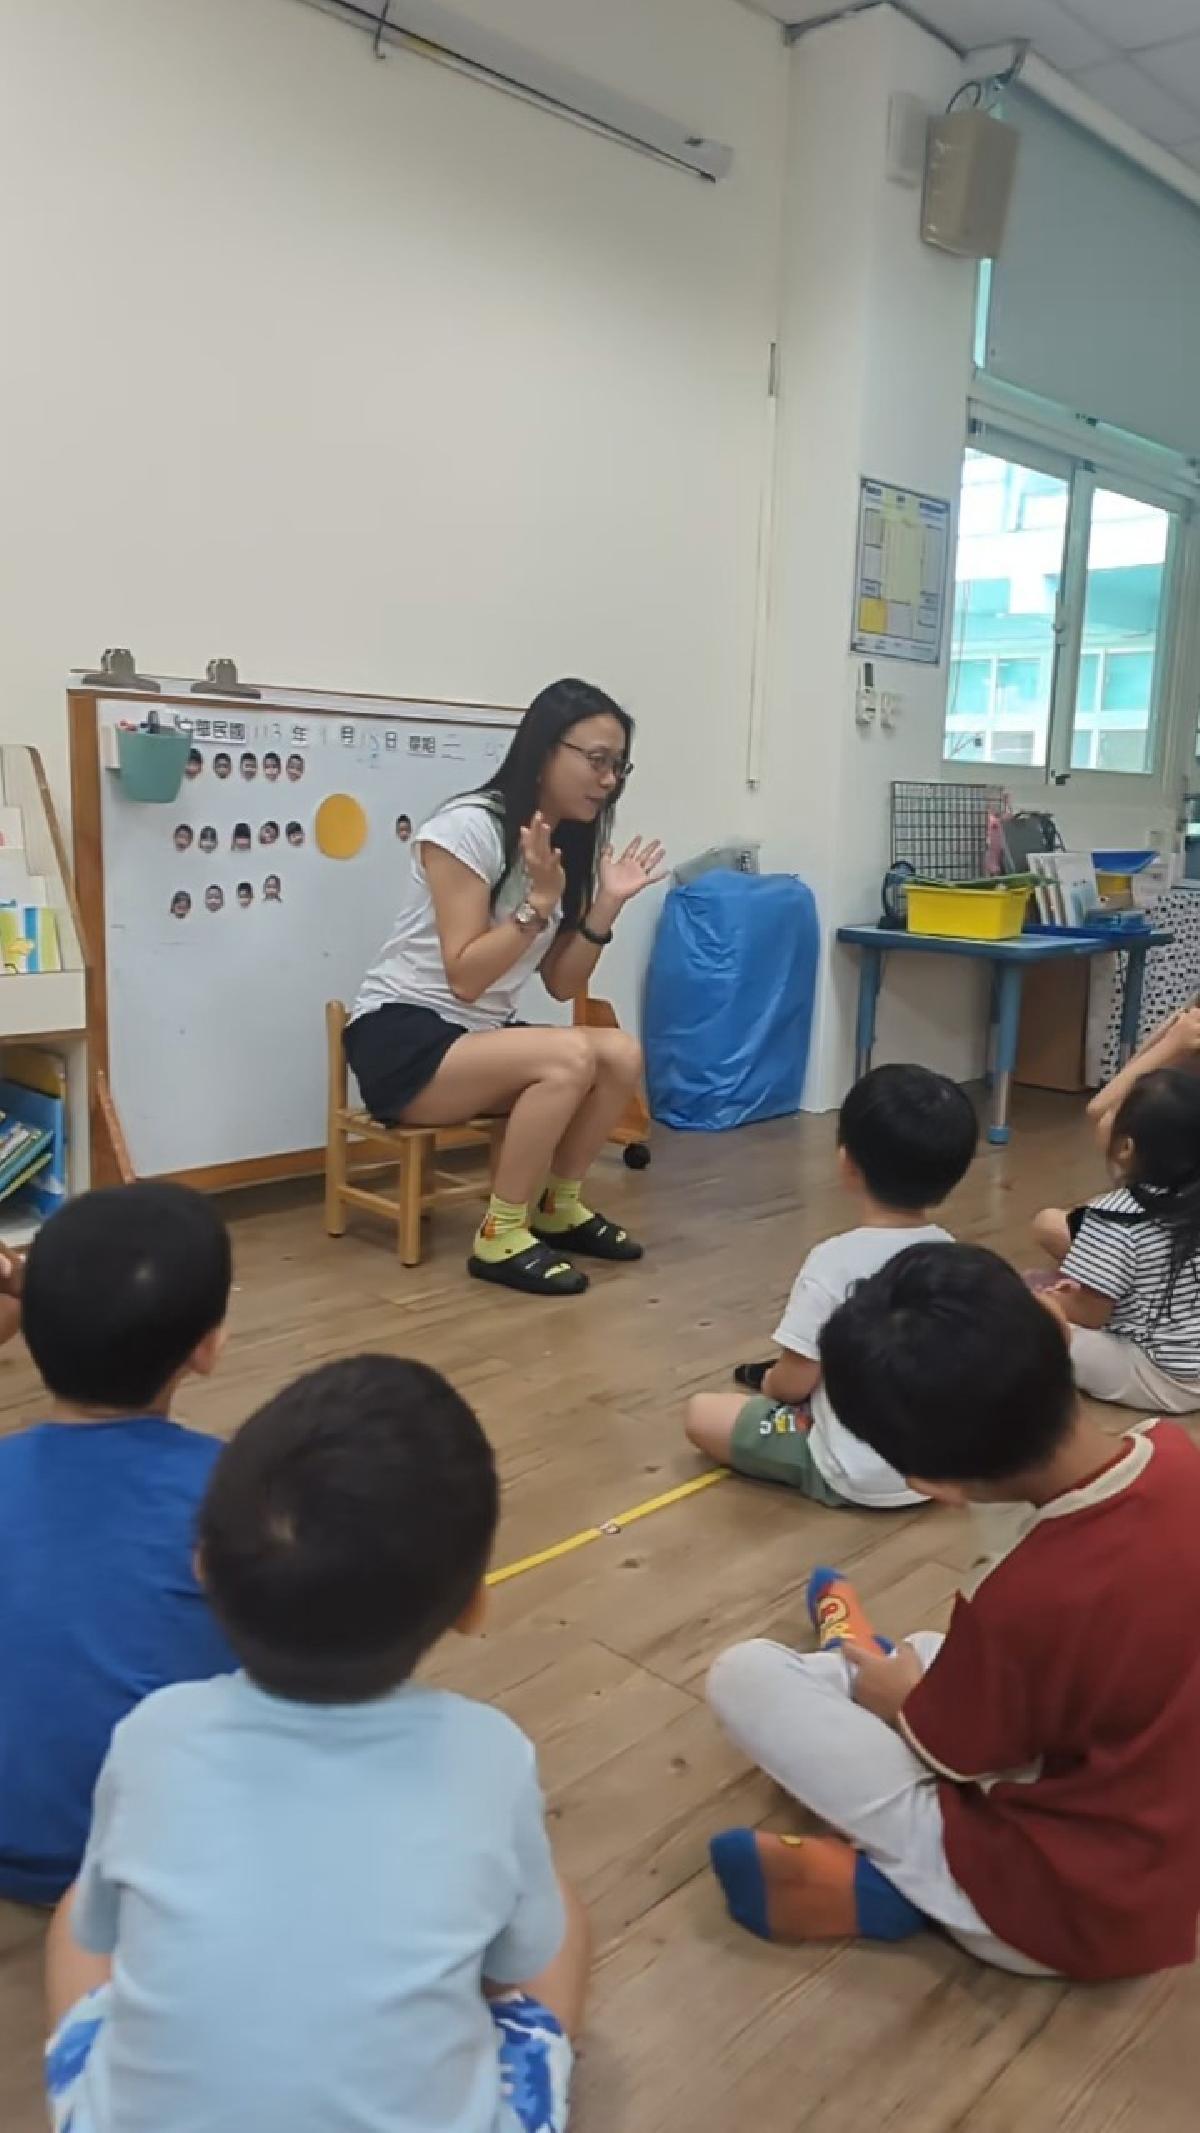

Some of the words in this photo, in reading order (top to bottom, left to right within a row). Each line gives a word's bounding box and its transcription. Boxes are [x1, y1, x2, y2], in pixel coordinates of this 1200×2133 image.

[291, 725, 308, 743] 年
[340, 725, 355, 745] 月
[385, 731, 397, 750] 日
